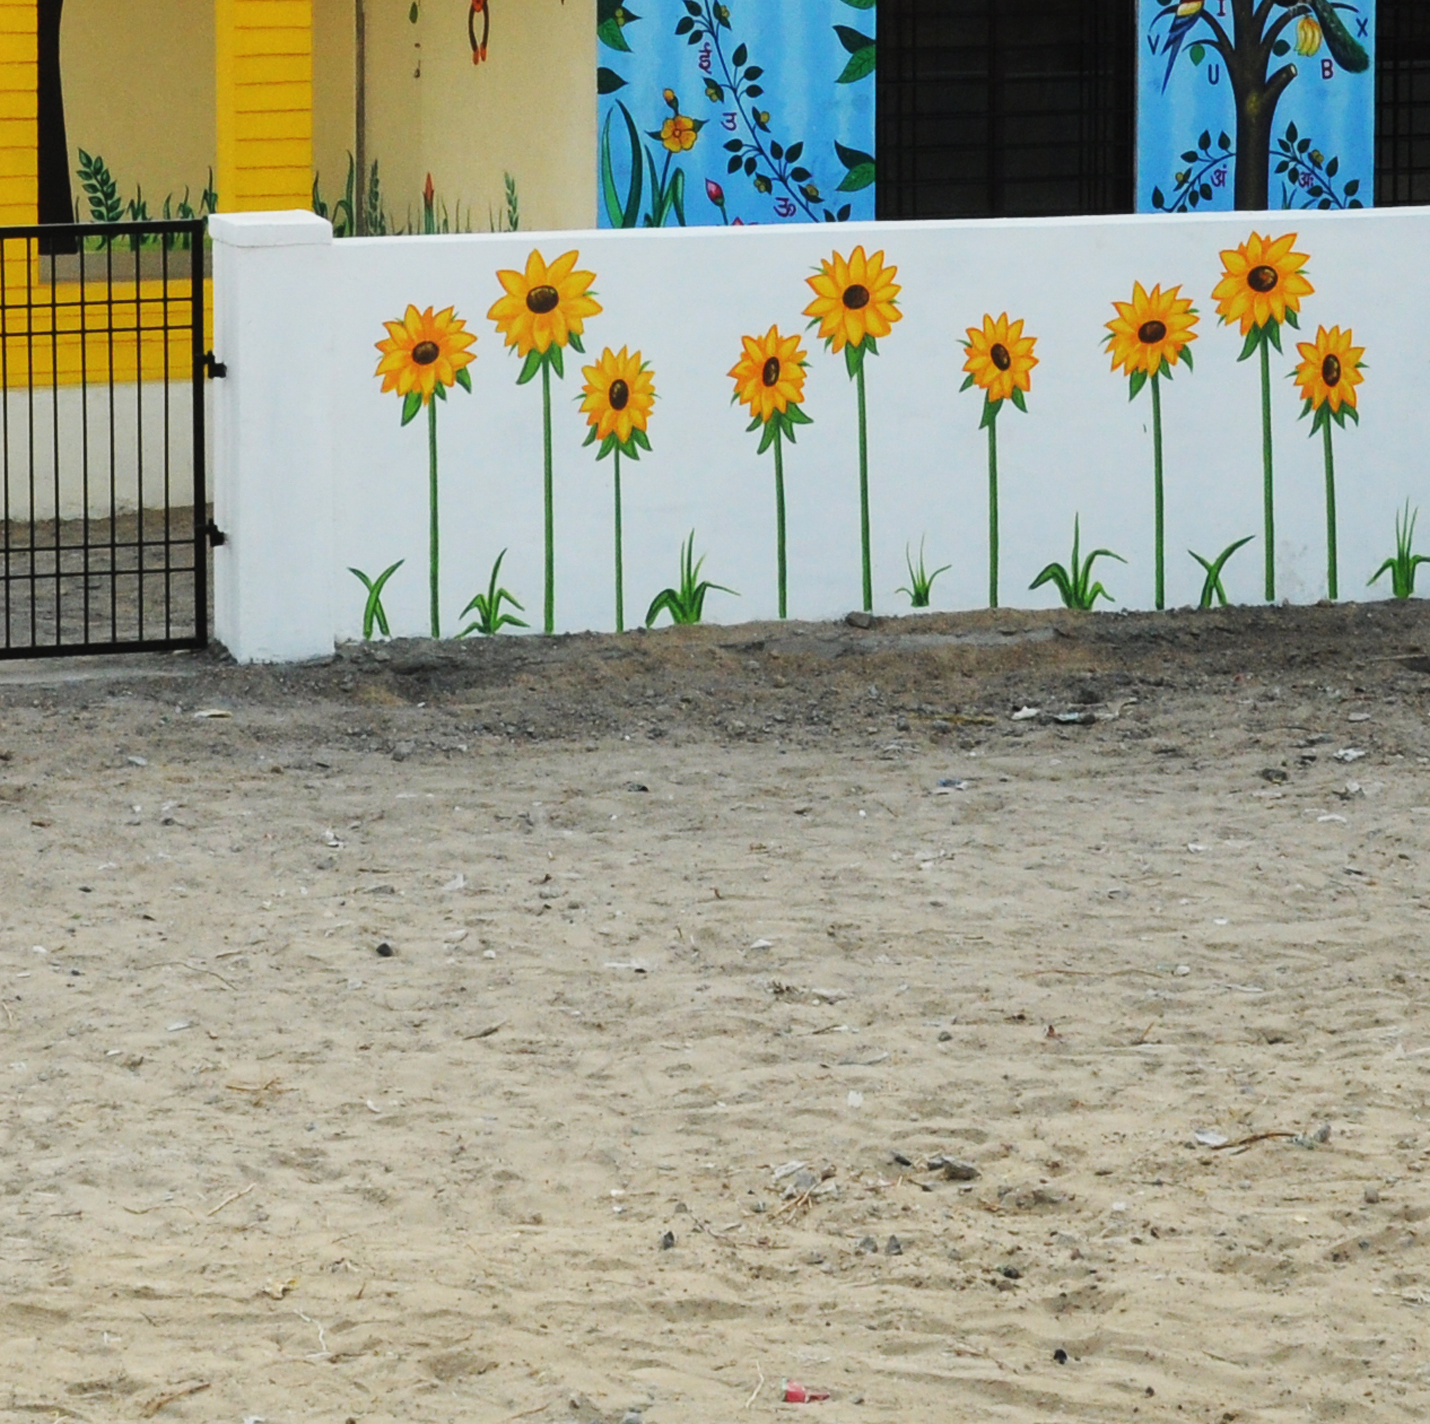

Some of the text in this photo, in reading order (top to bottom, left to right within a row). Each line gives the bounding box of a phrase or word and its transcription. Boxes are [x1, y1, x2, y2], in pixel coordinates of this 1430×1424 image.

[1356, 18, 1368, 37] X
[1148, 35, 1160, 55] V
[1208, 64, 1219, 85] U
[1321, 59, 1333, 79] B
